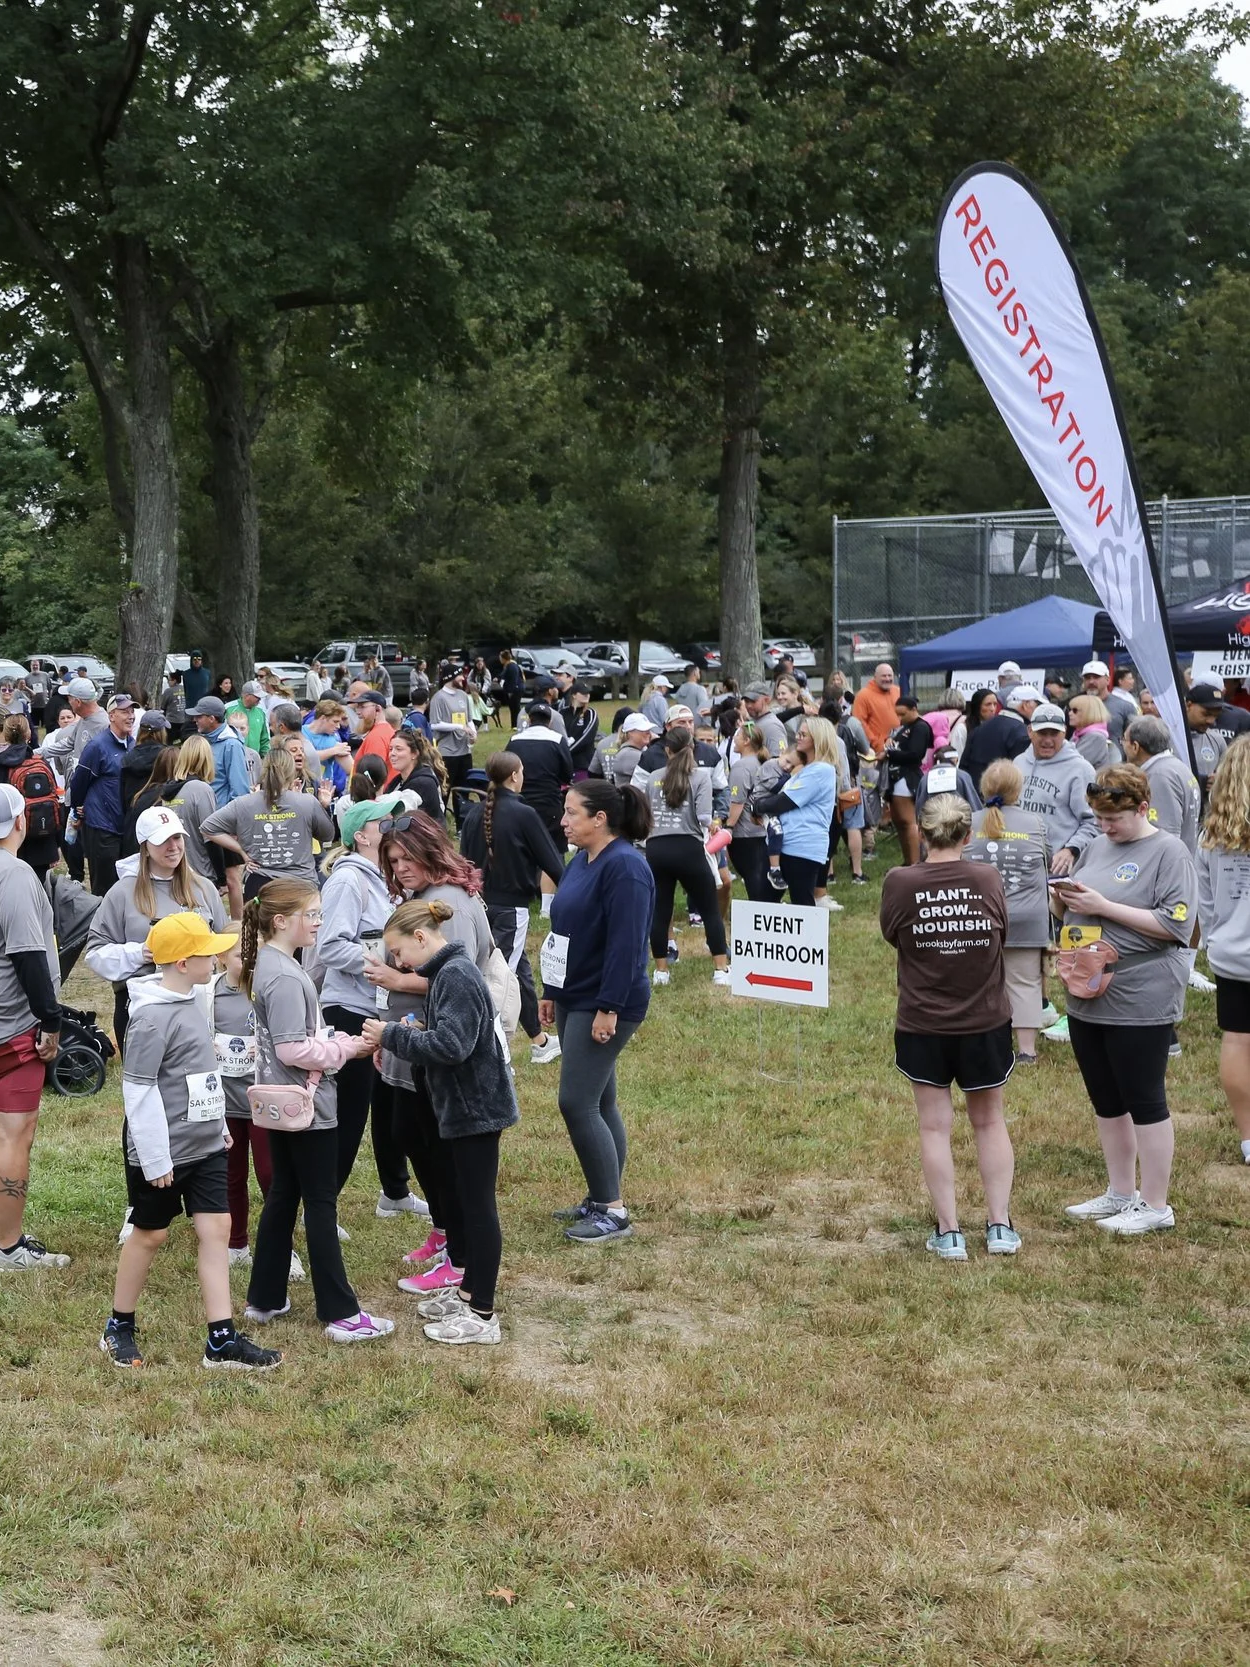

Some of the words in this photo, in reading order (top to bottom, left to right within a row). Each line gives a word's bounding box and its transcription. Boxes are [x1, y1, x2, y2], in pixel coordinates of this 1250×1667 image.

[955, 193, 1113, 527] REGISTRATION
[955, 680, 983, 691] Face
[1024, 789, 1034, 799] OF
[158, 813, 169, 824] B
[915, 888, 982, 904] PLANT...
[919, 904, 982, 919] GROW...
[753, 914, 803, 935] EVENT
[912, 919, 991, 934] NOURISH!
[916, 938, 990, 949] brooksbyfarm.org
[735, 939, 824, 966] BATHROOM
[215, 1054, 227, 1063] SAK
[190, 1099, 207, 1107] SAK
[268, 1104, 280, 1120] S
